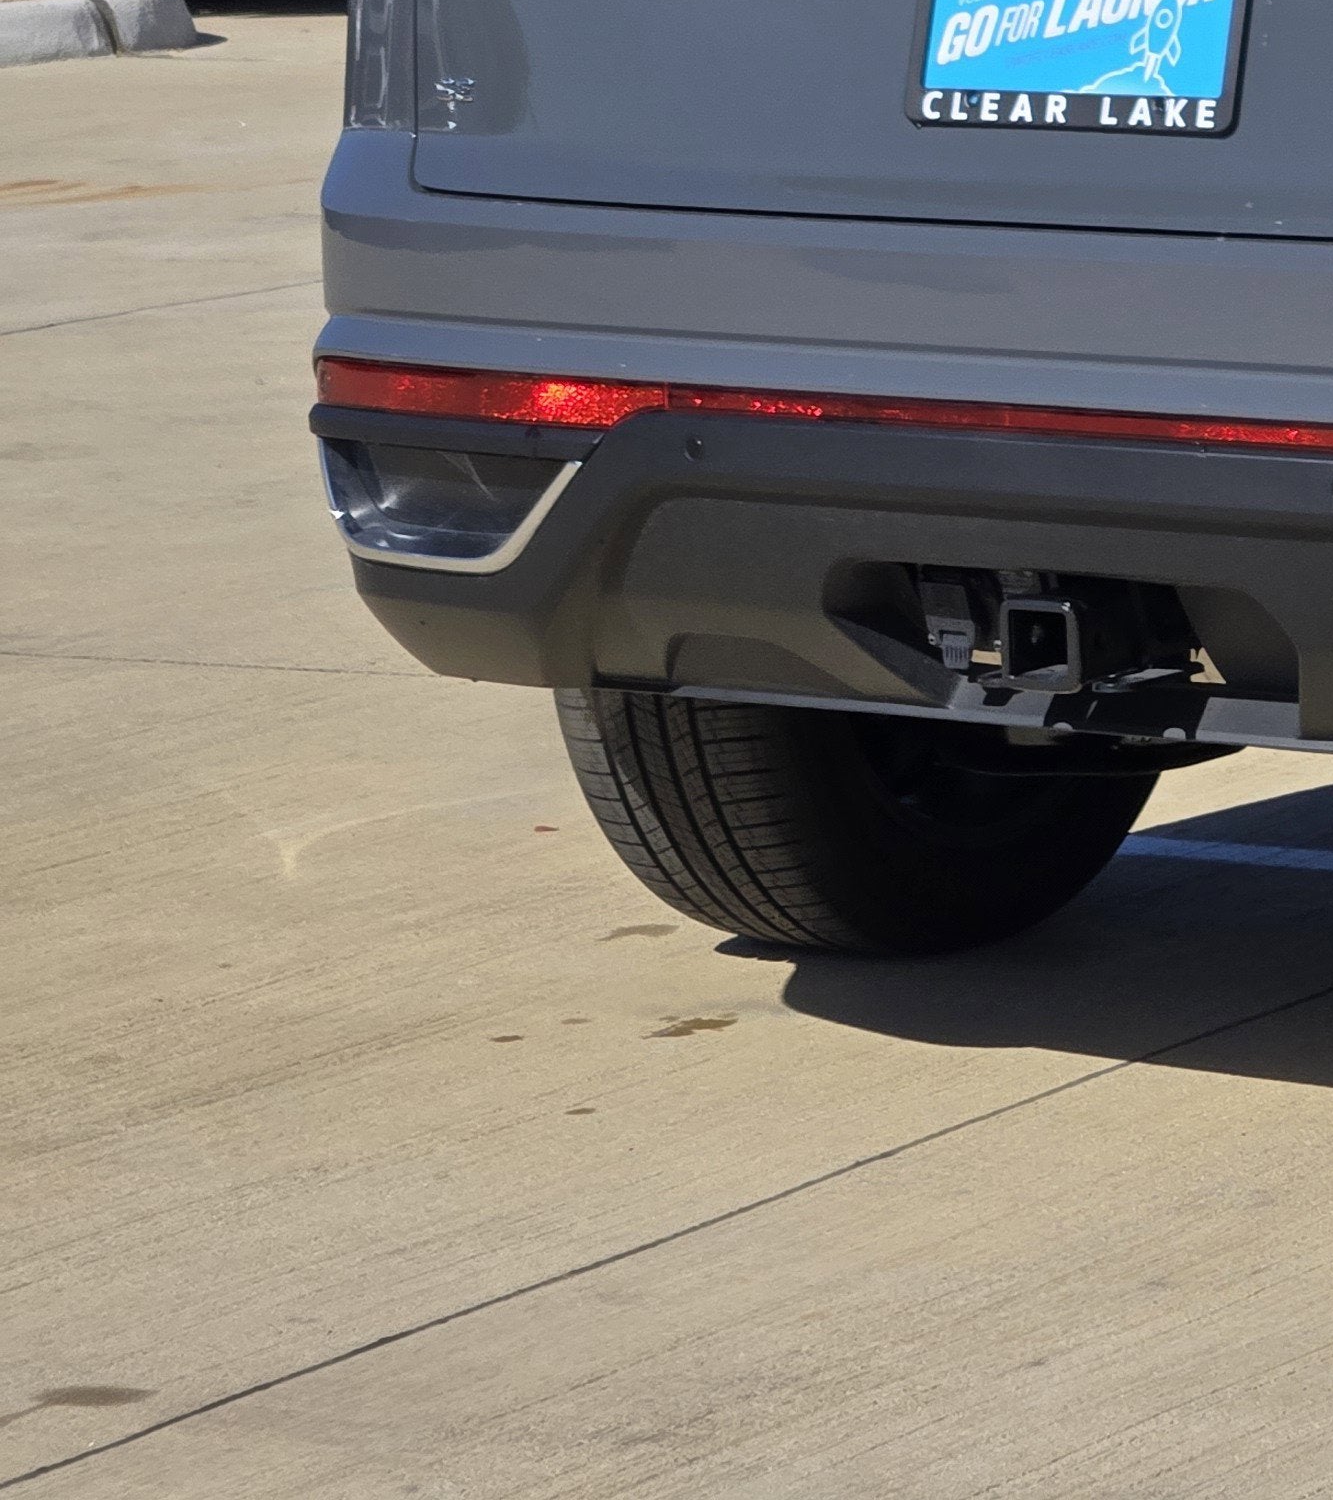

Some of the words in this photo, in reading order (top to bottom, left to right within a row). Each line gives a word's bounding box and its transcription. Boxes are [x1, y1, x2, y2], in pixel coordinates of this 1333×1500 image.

[936, 4, 1001, 65] GO
[994, 0, 1045, 47] FOR
[921, 91, 1067, 124] CLEAR
[1099, 96, 1217, 130] LAKE
